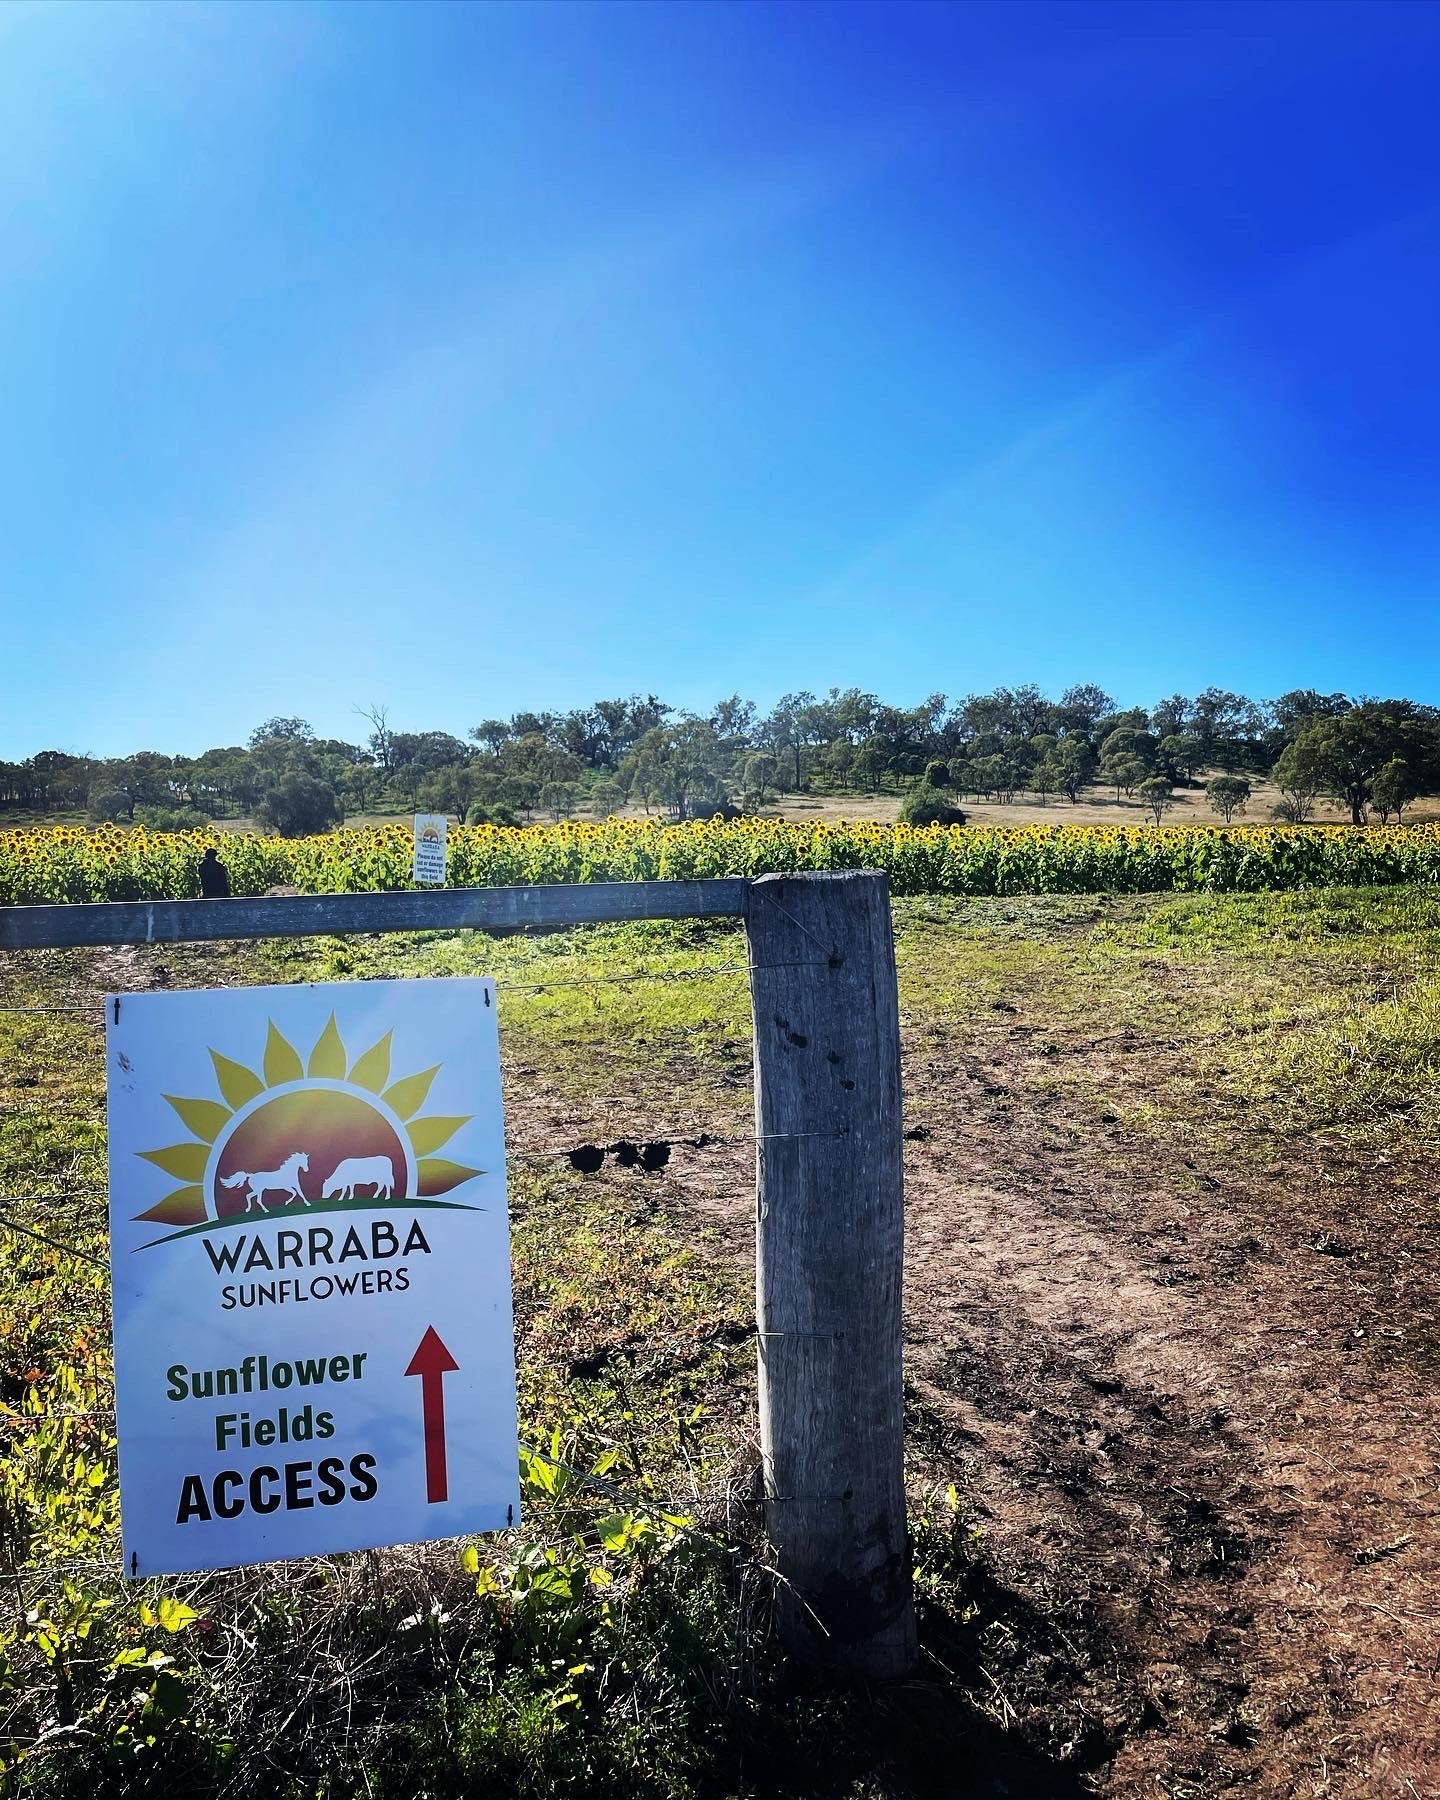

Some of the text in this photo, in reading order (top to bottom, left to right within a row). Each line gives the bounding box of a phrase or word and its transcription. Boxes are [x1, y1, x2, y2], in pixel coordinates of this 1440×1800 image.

[202, 1218, 431, 1275] WARRABA
[221, 1267, 410, 1310] SUNFLOWERS
[166, 1352, 368, 1401] Sunflower
[215, 1404, 335, 1451] Fields
[175, 1453, 378, 1525] ACCESS
